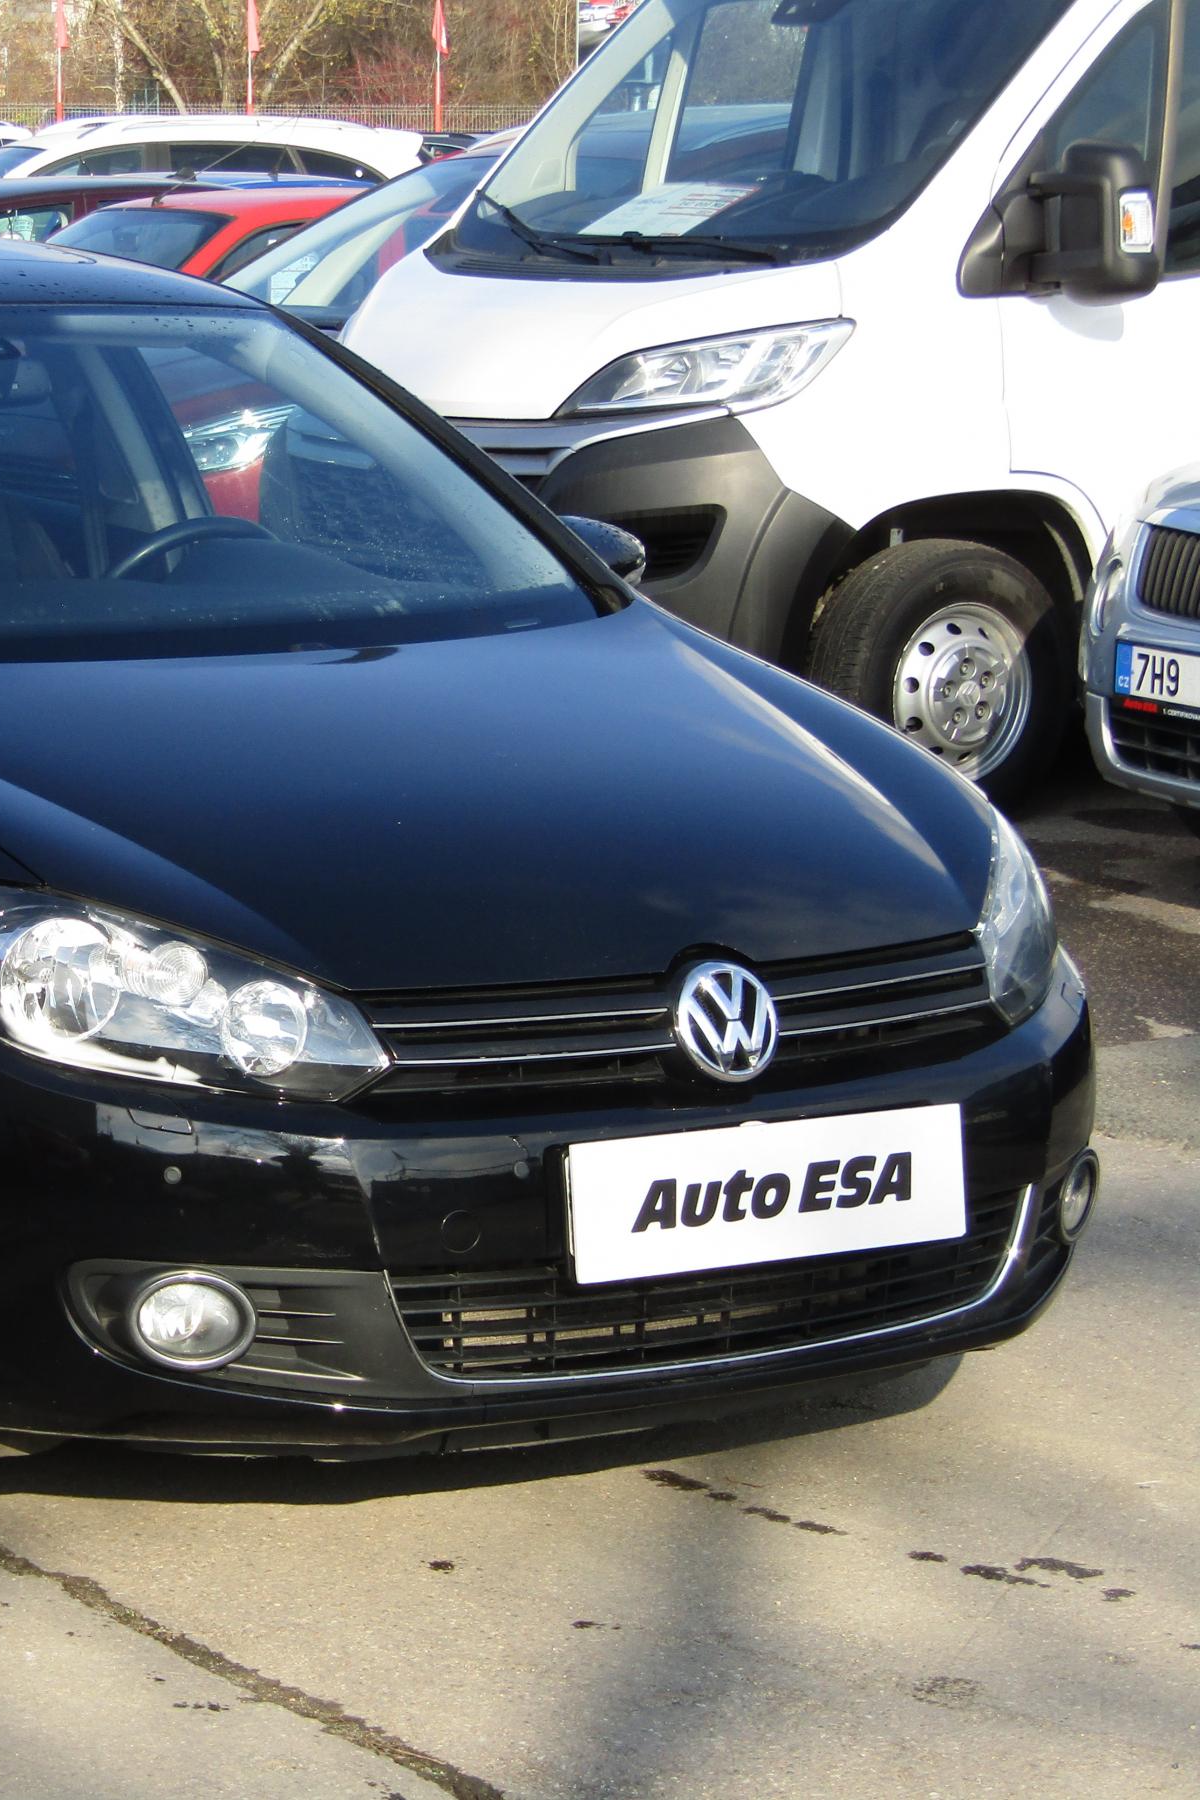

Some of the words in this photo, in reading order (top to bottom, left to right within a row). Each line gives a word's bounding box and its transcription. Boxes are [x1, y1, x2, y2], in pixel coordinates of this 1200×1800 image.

[1118, 675, 1130, 688] CZ
[1135, 652, 1180, 698] 7H9
[631, 1169, 791, 1233] Auto
[798, 1151, 912, 1213] ESA
